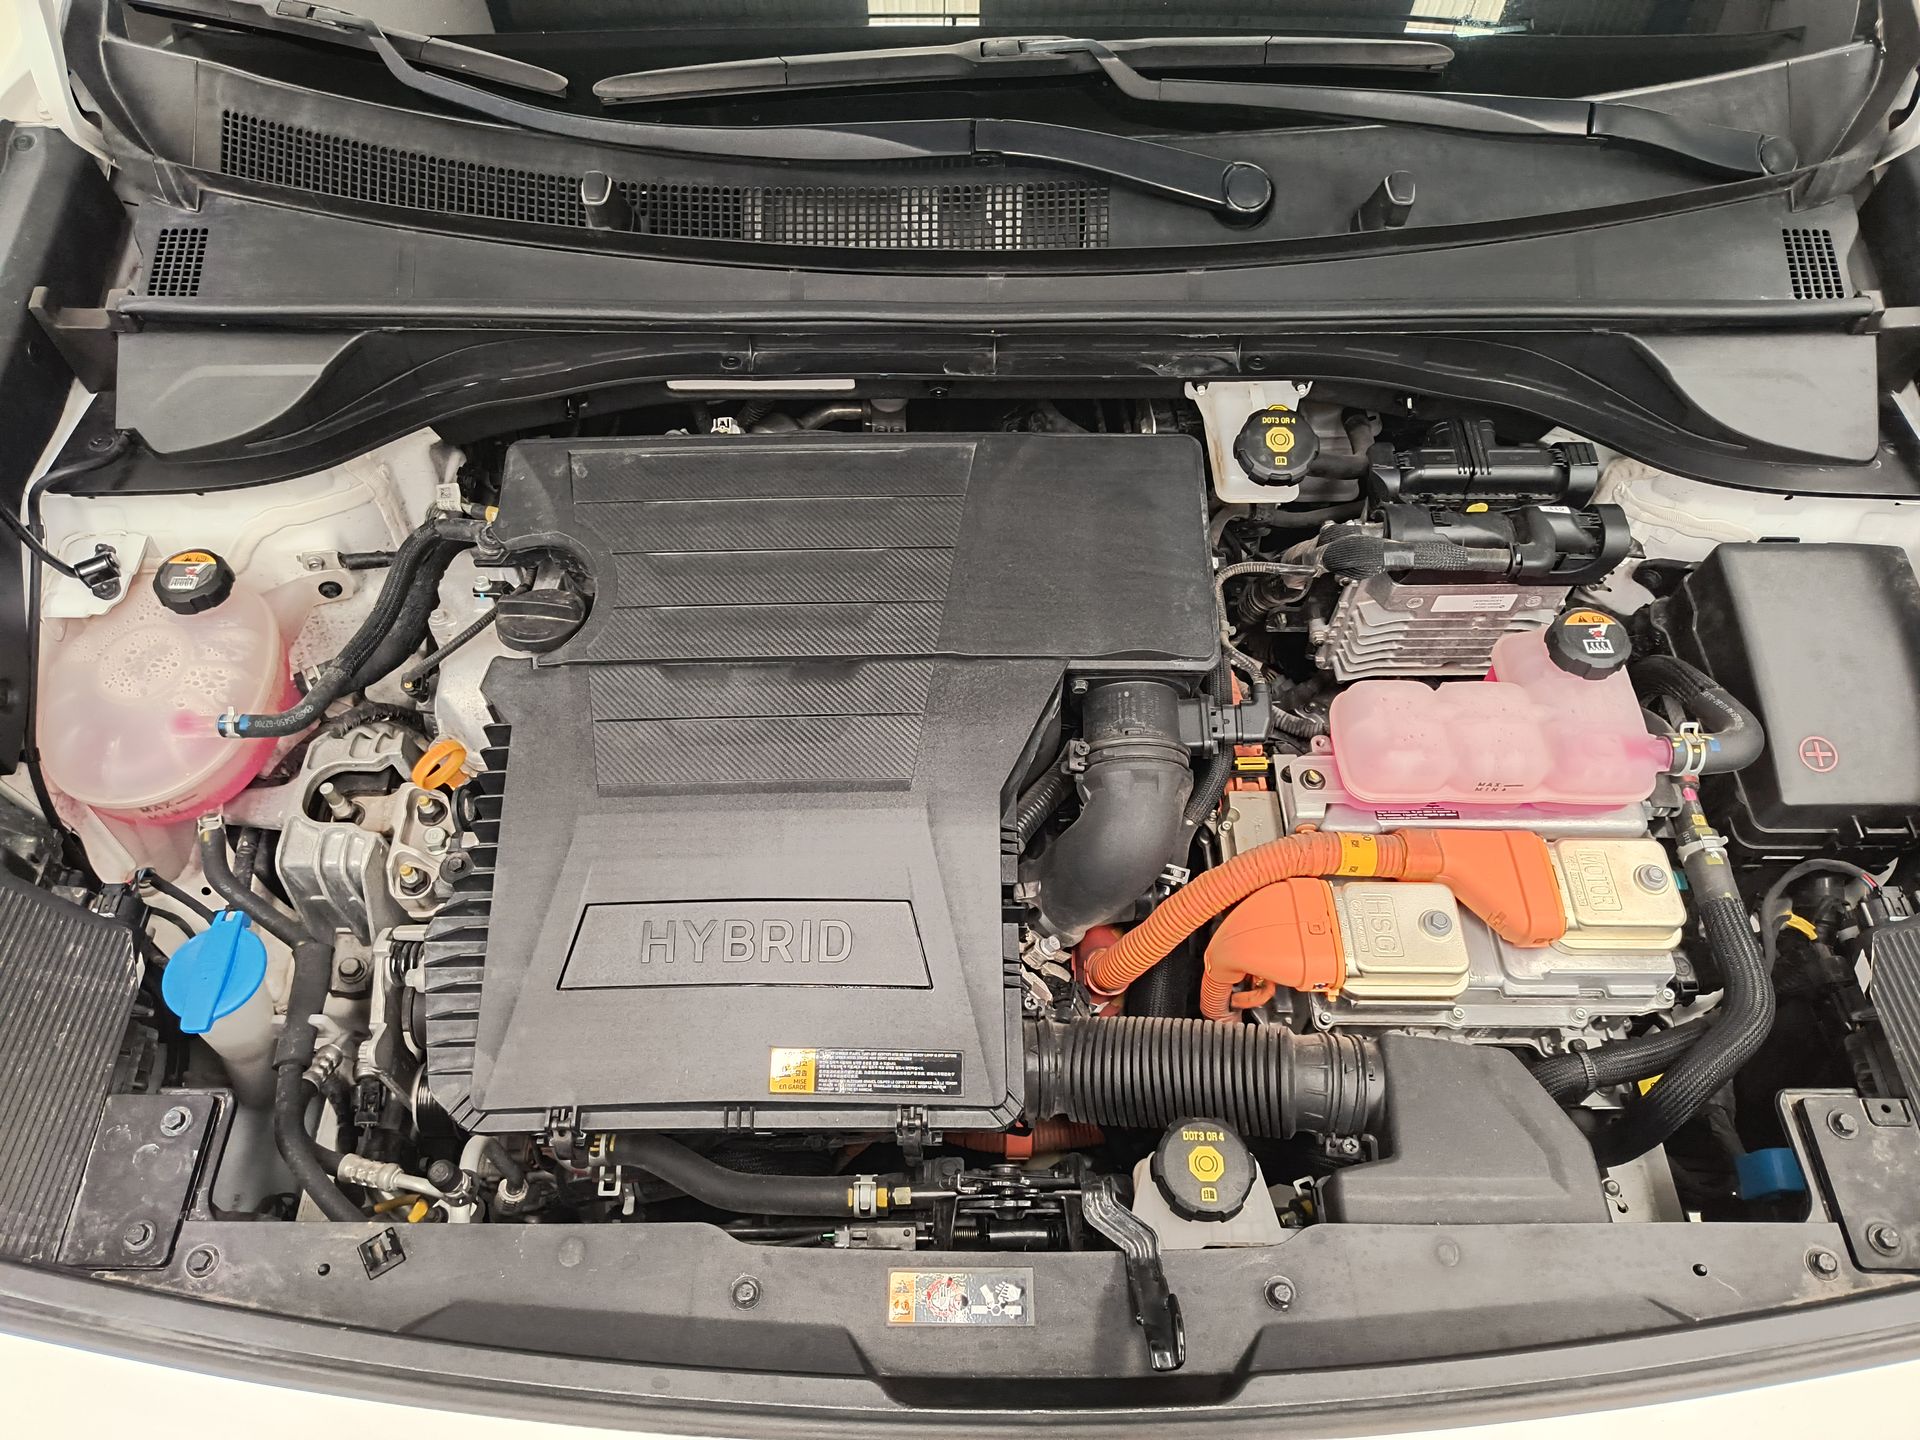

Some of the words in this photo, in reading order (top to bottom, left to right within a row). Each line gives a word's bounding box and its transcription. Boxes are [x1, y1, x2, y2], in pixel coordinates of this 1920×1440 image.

[1580, 853, 1615, 905] MOTOR
[641, 919, 853, 963] HYBRID
[1366, 897, 1396, 953] HSG
[1182, 1130, 1205, 1141] DOT3
[1206, 1131, 1217, 1142] OR
[1218, 1131, 1225, 1142] 4
